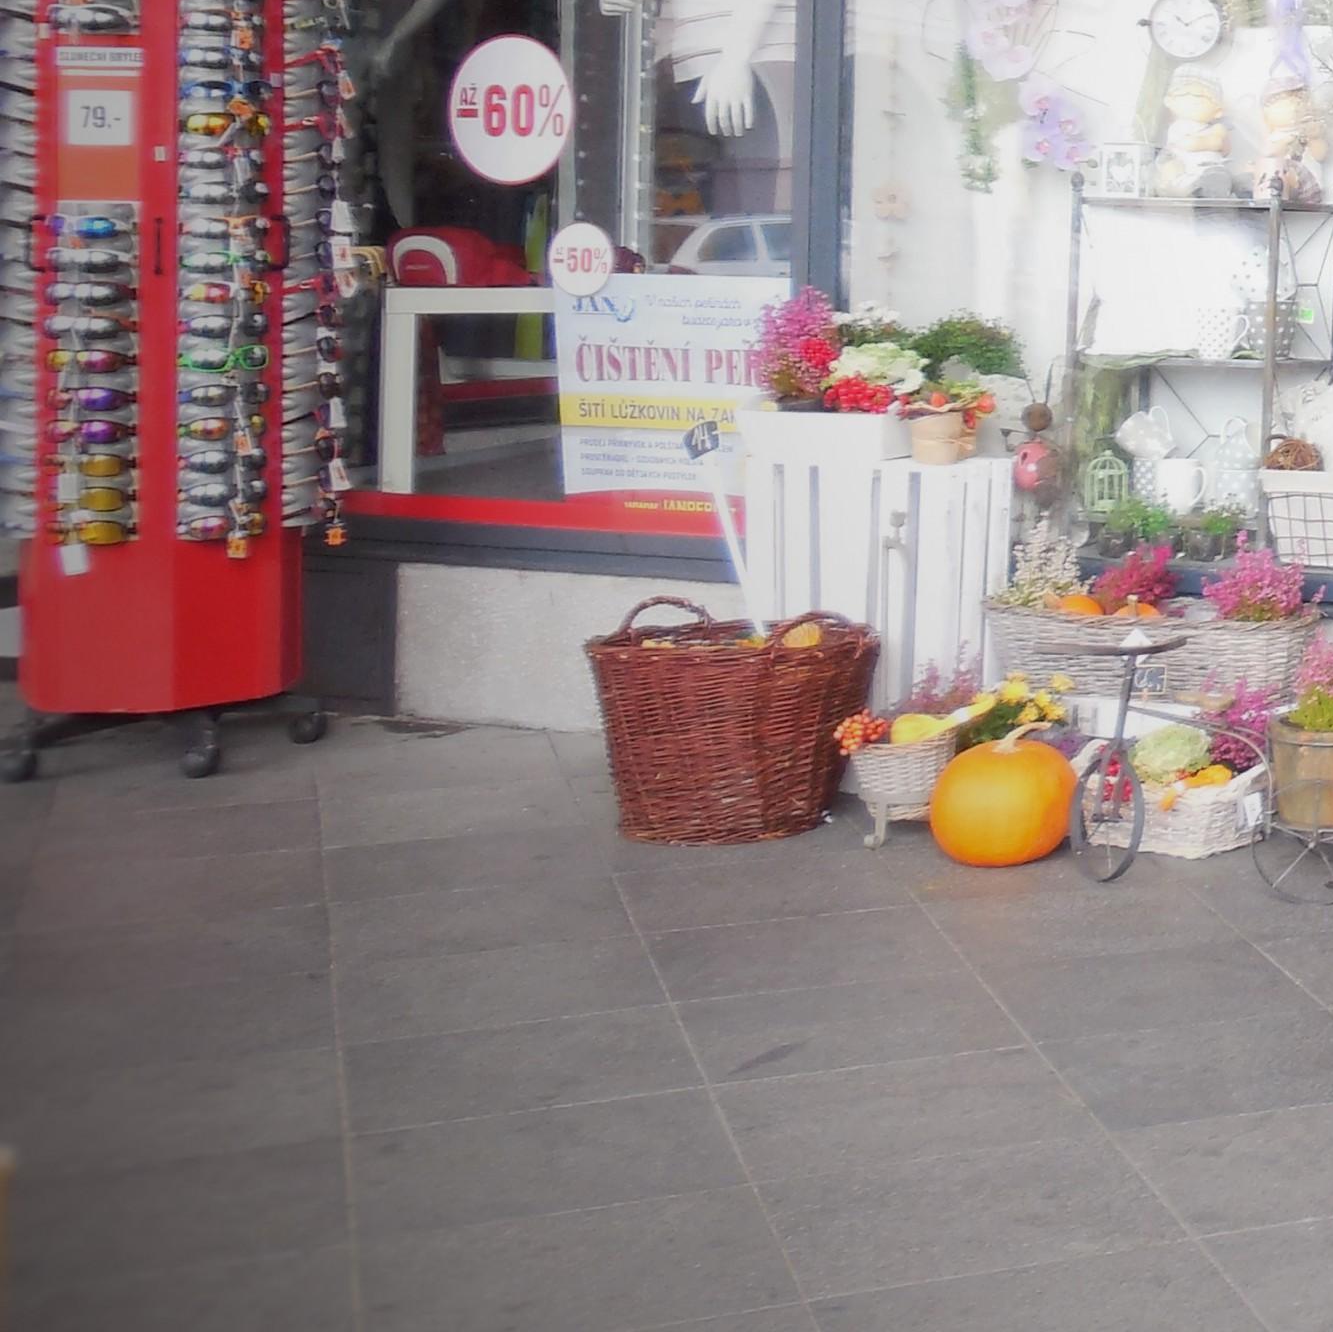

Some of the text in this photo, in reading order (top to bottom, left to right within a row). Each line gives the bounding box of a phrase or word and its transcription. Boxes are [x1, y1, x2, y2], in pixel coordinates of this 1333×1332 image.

[459, 84, 478, 105] AŽ
[575, 335, 765, 387] ČIŠTĚNÍ PEŘ
[578, 399, 606, 419] ŠITÍ
[611, 400, 680, 421] LŮŽKOVIN
